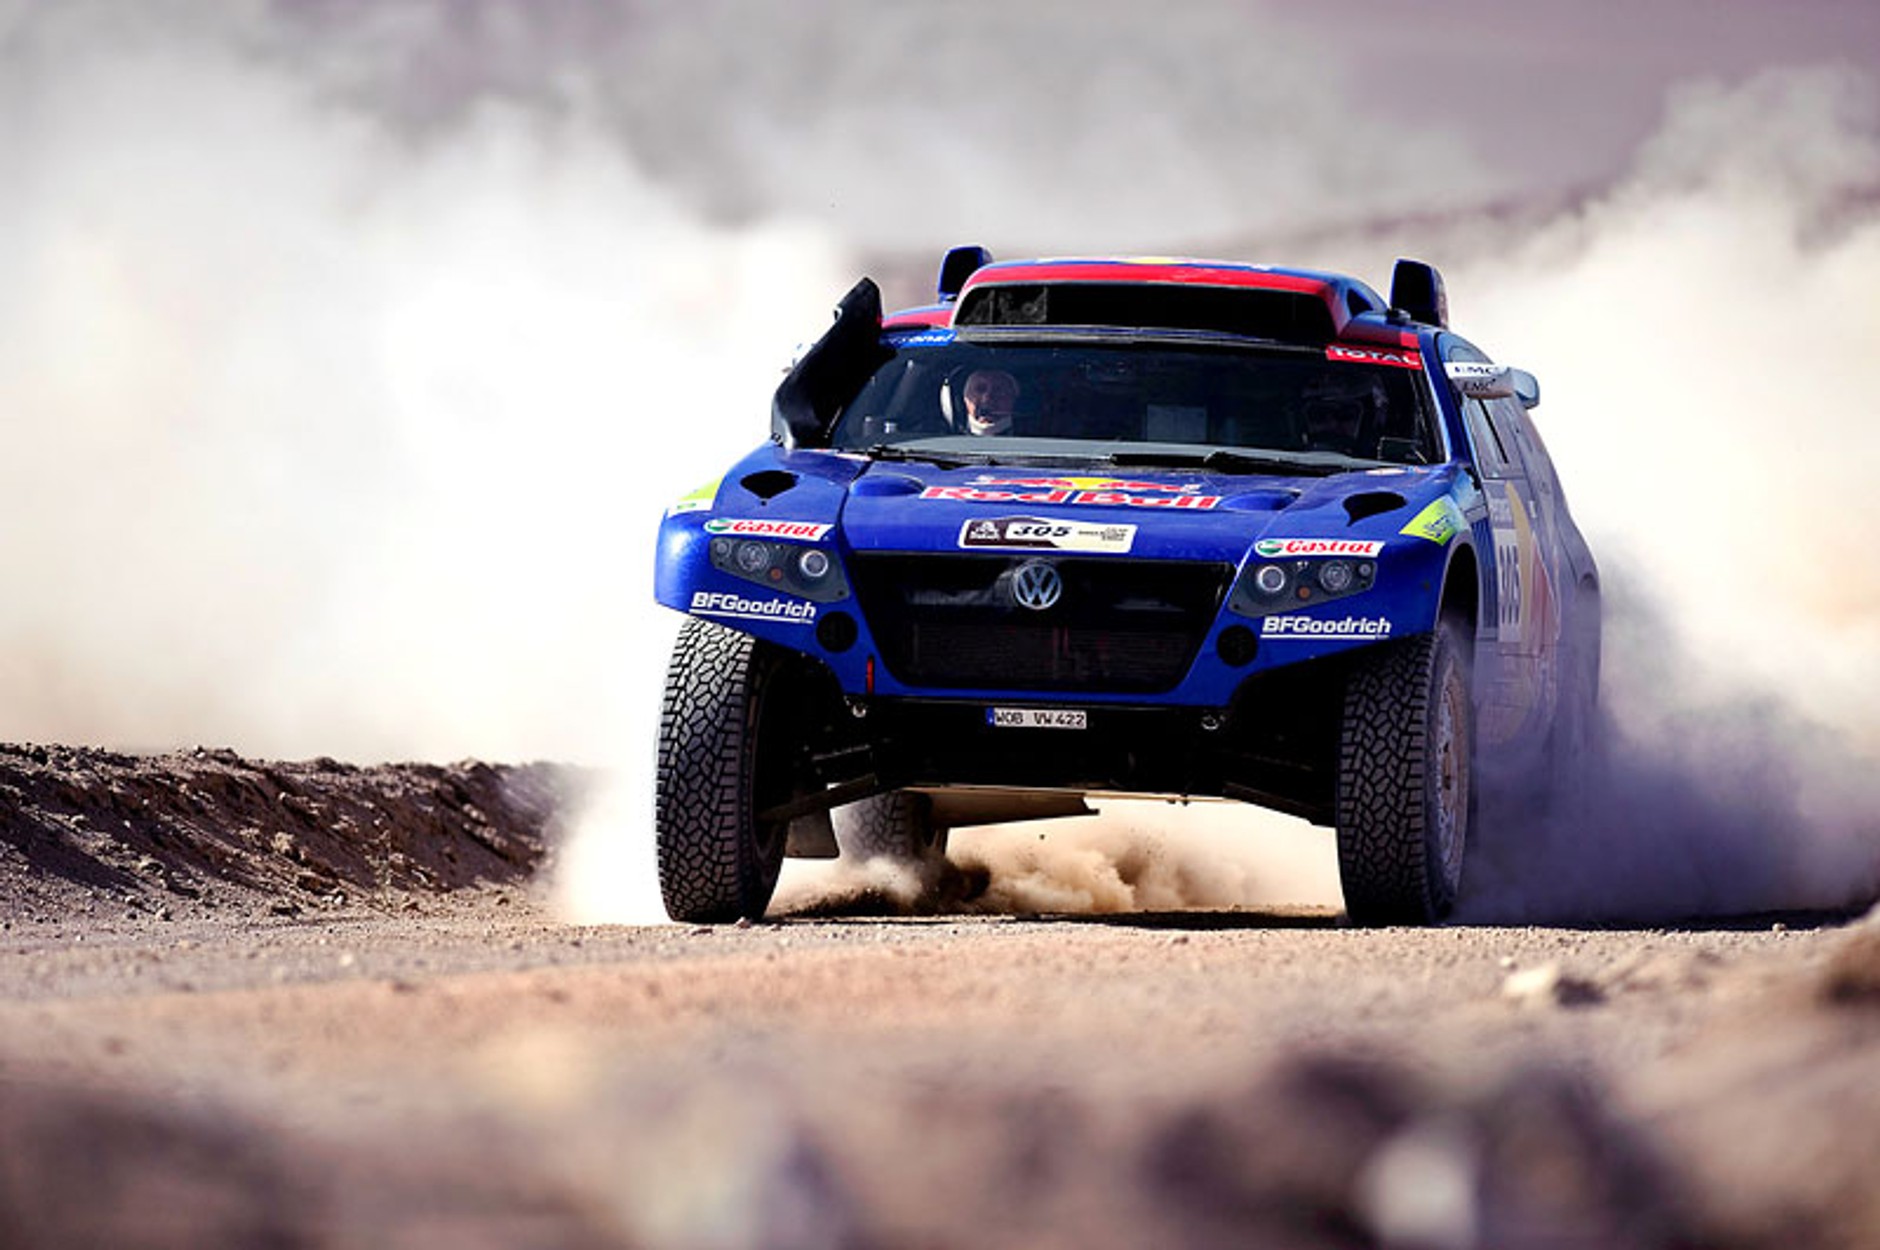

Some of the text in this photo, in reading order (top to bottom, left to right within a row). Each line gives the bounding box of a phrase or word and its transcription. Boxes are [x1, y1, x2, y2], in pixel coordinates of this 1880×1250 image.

[1328, 345, 1420, 367] TOTAL
[733, 520, 820, 537] Castrol
[1013, 525, 1072, 538] 305
[1285, 540, 1375, 554] Castrol
[691, 591, 817, 618] BFGoodrich
[1262, 615, 1392, 634] BFGoodrich
[1034, 711, 1054, 725] VW
[1056, 712, 1085, 728] 422
